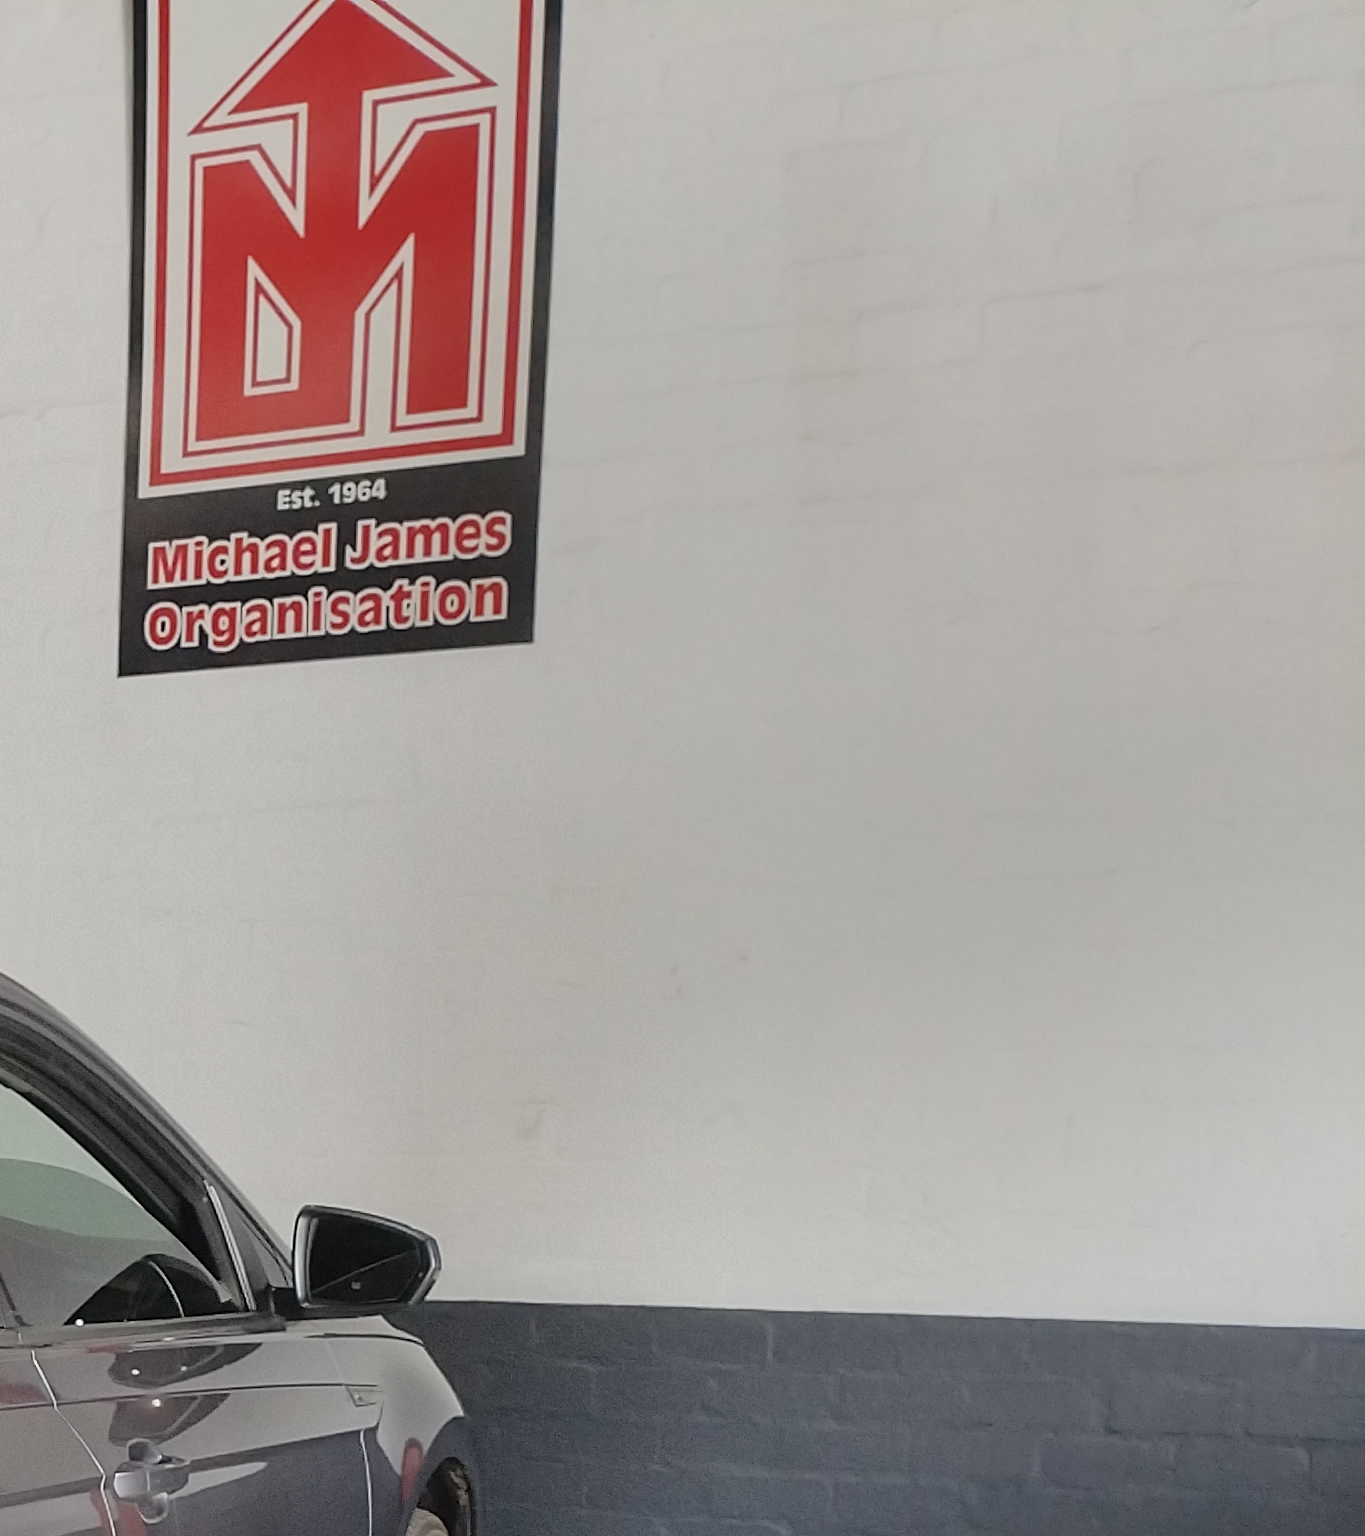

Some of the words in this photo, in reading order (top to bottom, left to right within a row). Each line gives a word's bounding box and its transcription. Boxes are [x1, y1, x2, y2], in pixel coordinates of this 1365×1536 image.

[275, 485, 321, 511] Est.
[328, 478, 387, 505] 1964
[146, 522, 337, 590] Michael
[344, 510, 512, 567] James
[144, 575, 509, 654] Organisation
